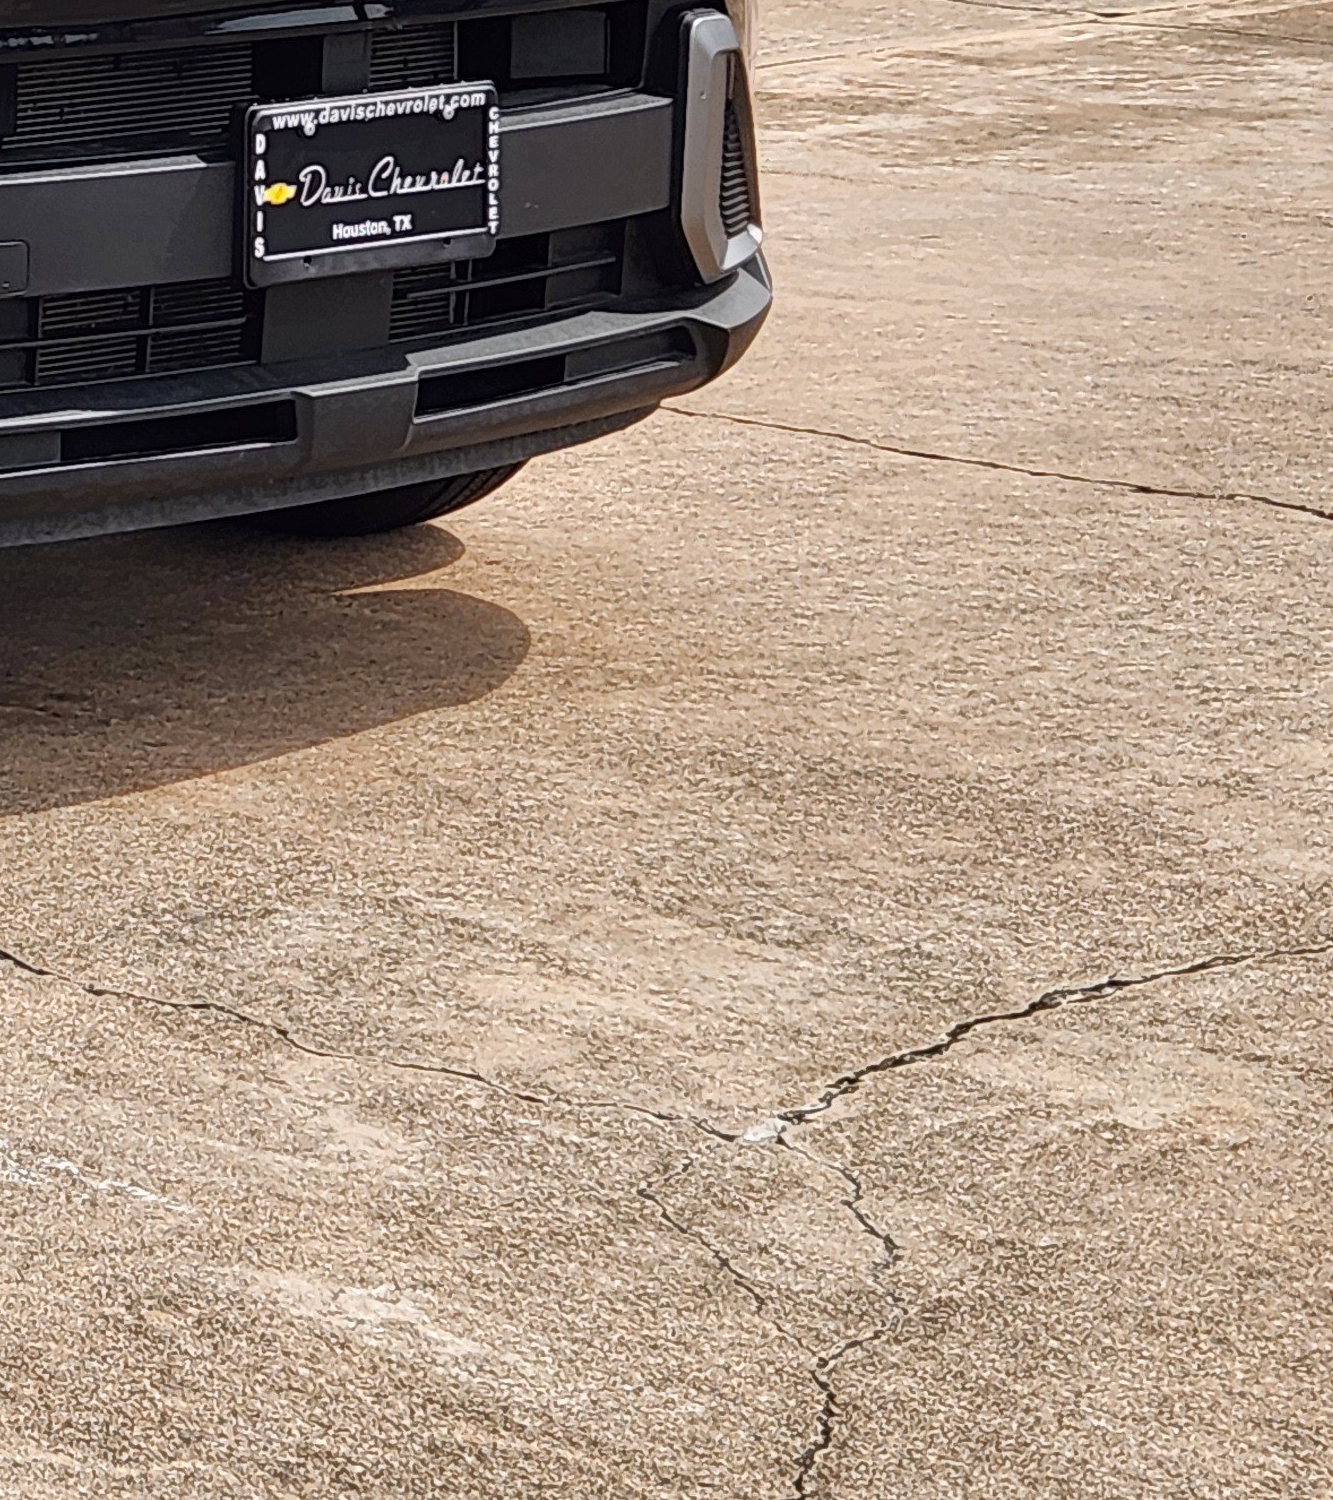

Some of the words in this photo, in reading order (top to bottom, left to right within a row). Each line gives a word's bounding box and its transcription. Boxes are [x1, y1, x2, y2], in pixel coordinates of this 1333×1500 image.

[272, 93, 487, 130] www.davischevrolet.com
[254, 133, 266, 258] DAVIS
[299, 164, 368, 207] Davis
[367, 155, 487, 199] Chevrolet
[488, 106, 501, 235] CHEVROLET
[332, 221, 392, 241] Houston,
[393, 214, 413, 232] TX
